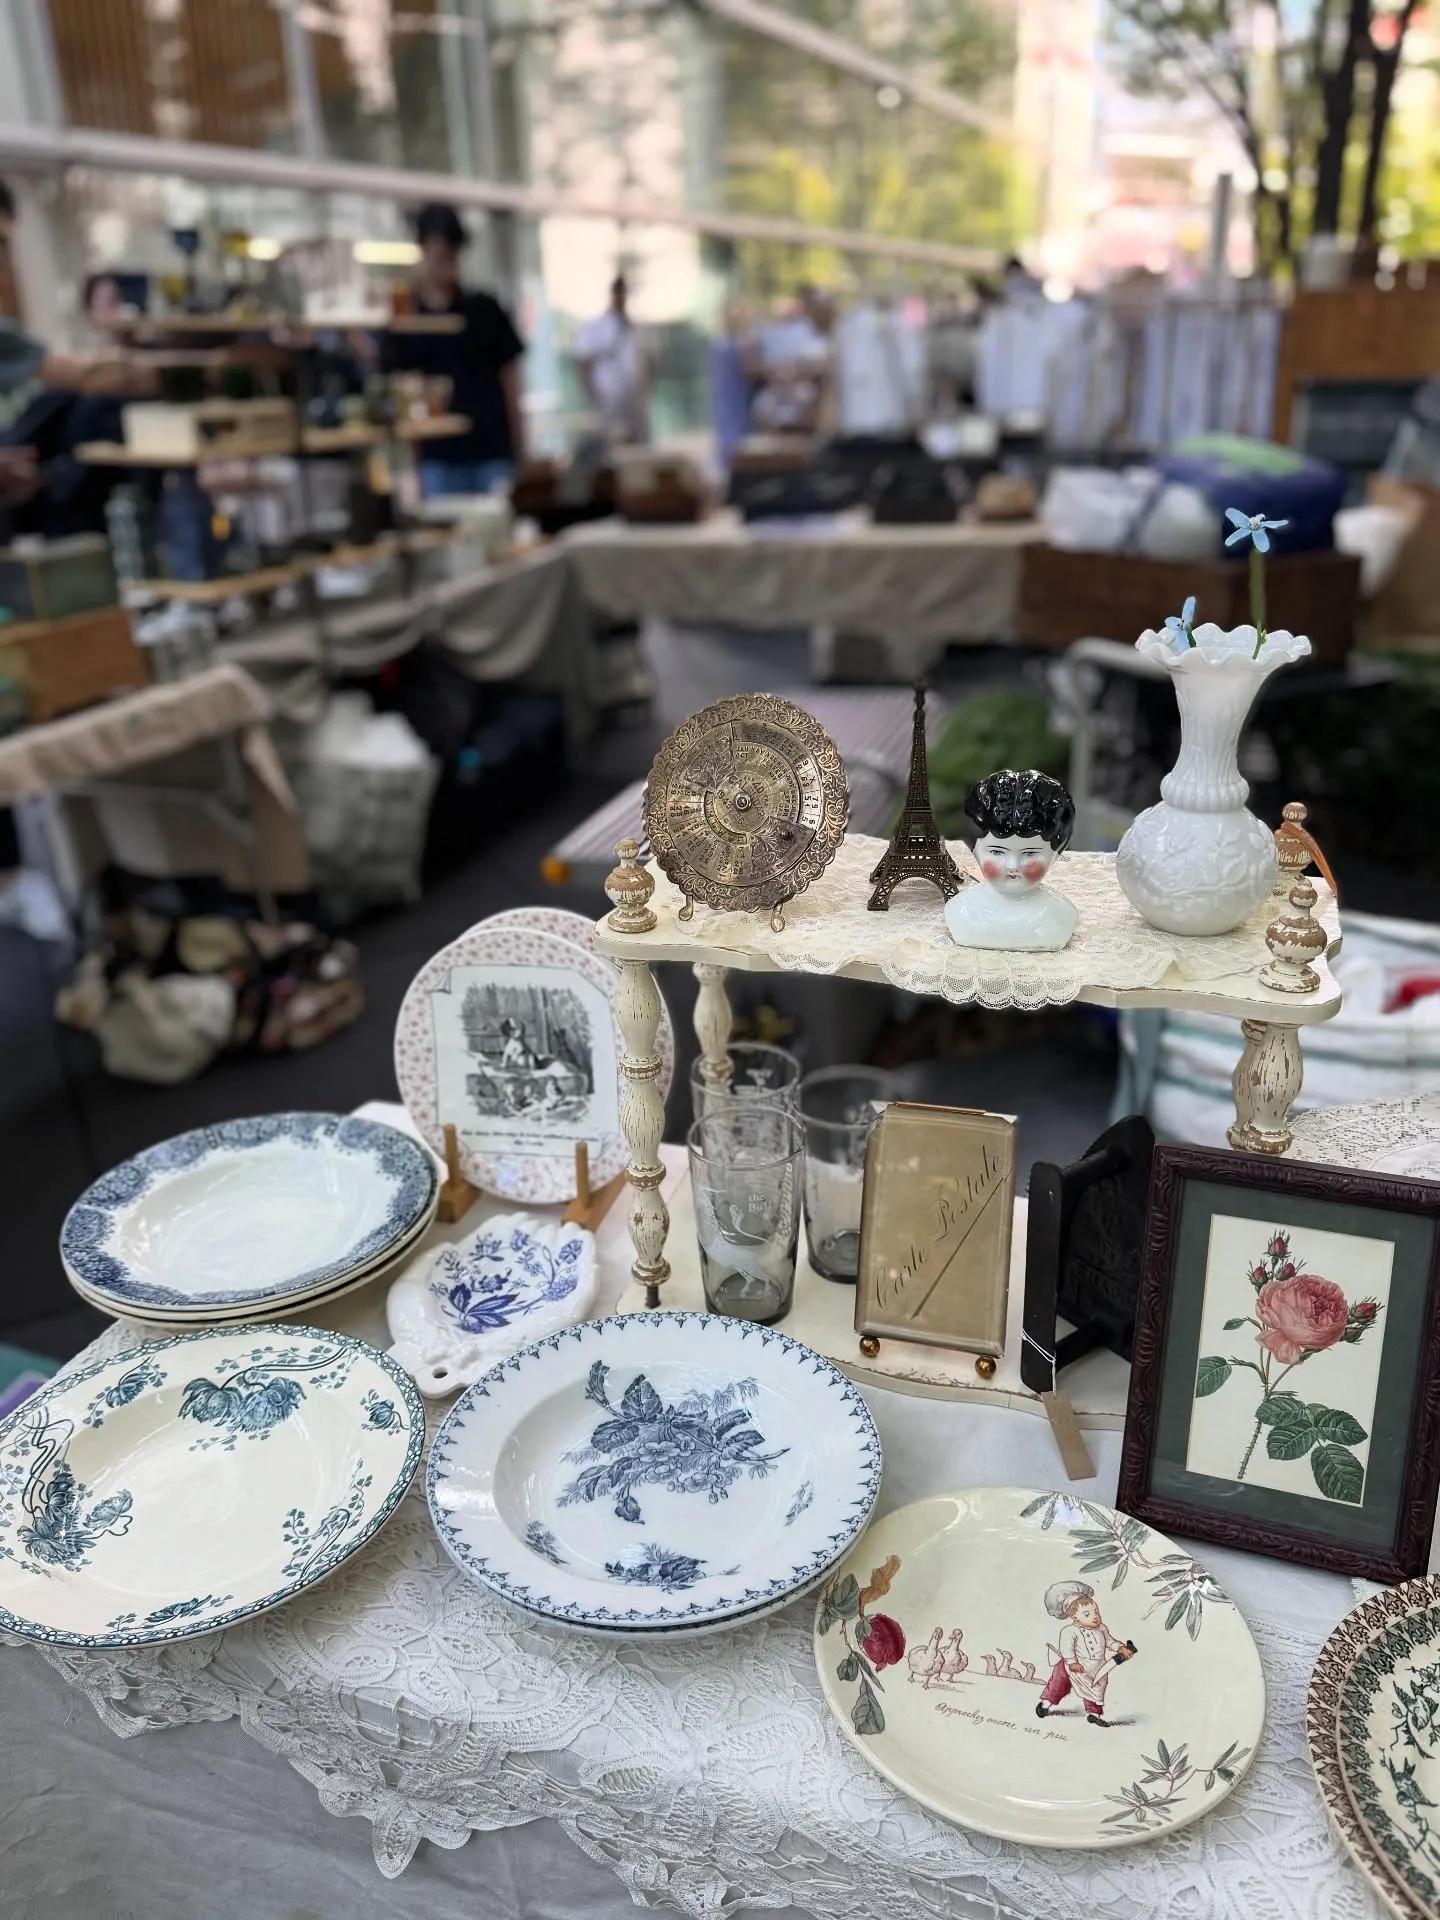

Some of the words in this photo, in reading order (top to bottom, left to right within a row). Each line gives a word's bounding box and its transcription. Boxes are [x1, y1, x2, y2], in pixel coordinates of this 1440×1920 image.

[729, 774, 766, 820] CALENDAR
[804, 795, 812, 807] 51
[812, 795, 819, 809] 79
[747, 1192, 767, 1203] the
[875, 1243, 929, 1311] Carte
[929, 1145, 1002, 1242] Postale
[934, 1702, 985, 1726] Approchez
[986, 1716, 1018, 1730] encore
[1022, 1726, 1041, 1736] un
[1043, 1730, 1069, 1742] peu
